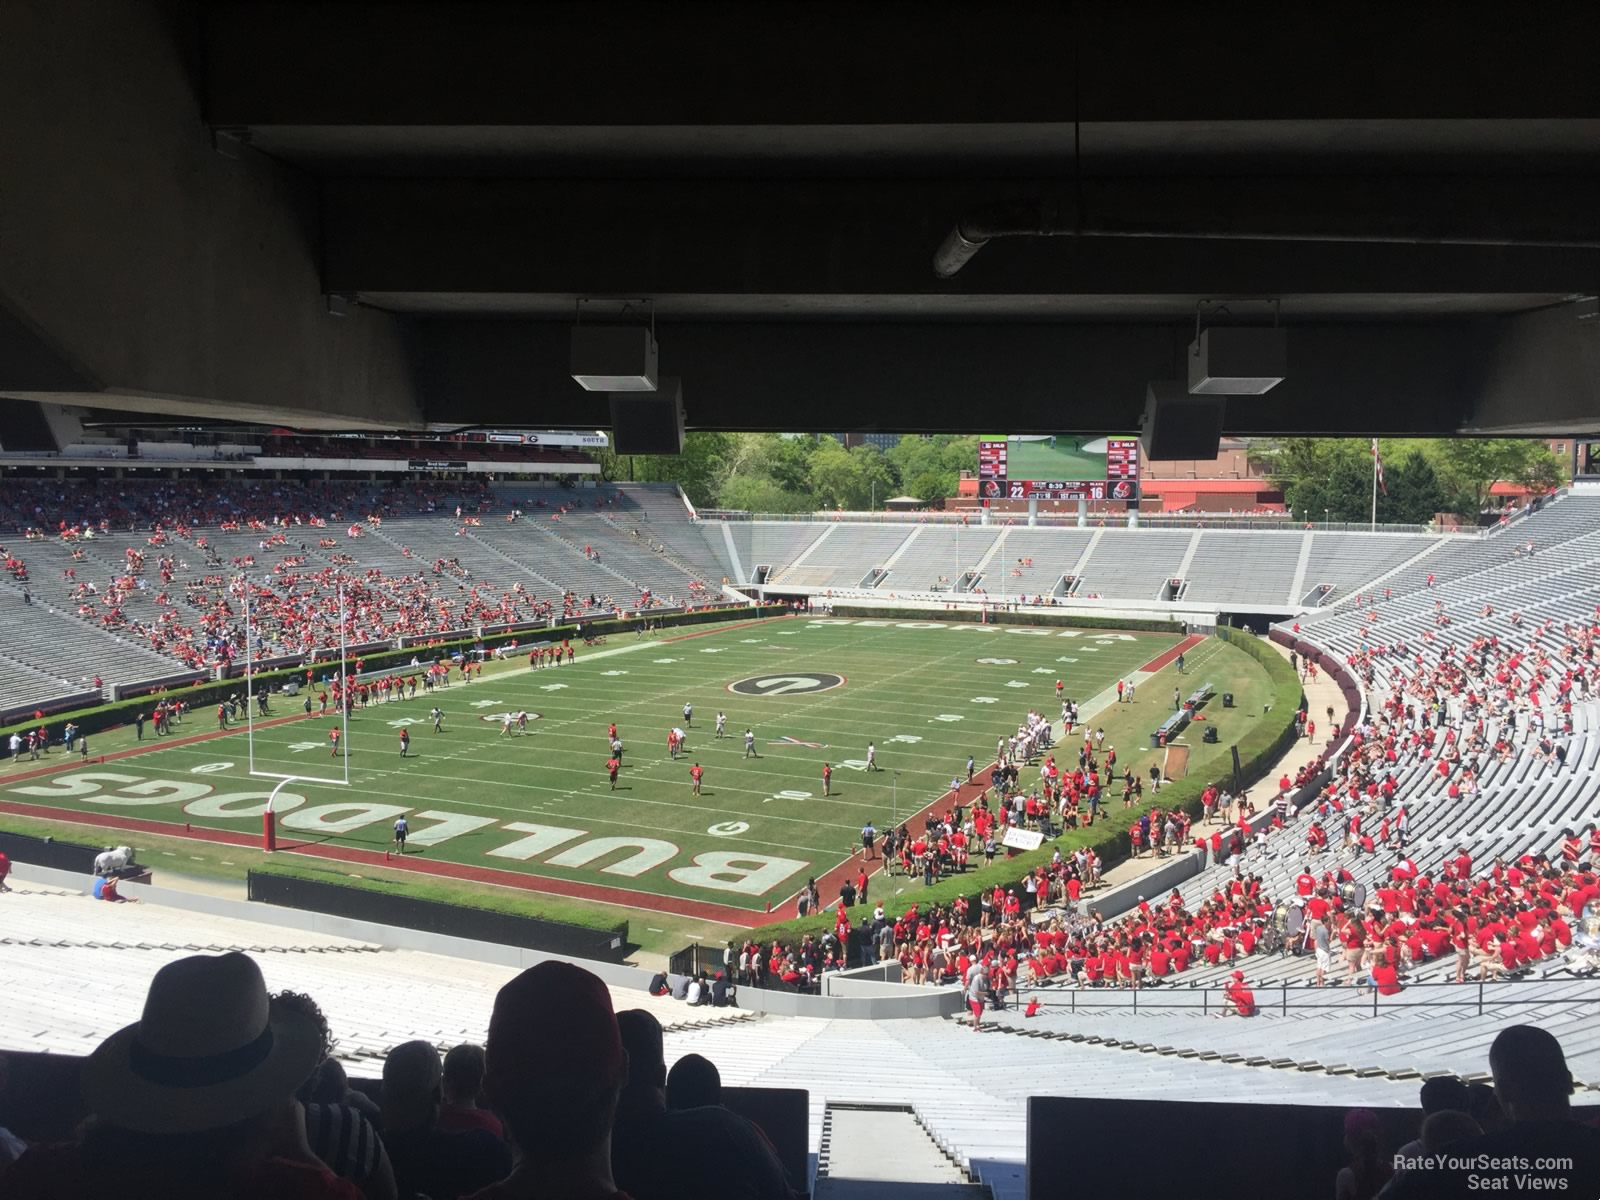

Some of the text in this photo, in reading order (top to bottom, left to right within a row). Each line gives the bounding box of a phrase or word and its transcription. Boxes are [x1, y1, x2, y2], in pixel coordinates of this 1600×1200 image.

[1011, 487, 1024, 498] 22
[1090, 487, 1103, 499] 16
[808, 619, 1137, 641] GEORGIA
[5, 772, 811, 896] BULLDOGS
